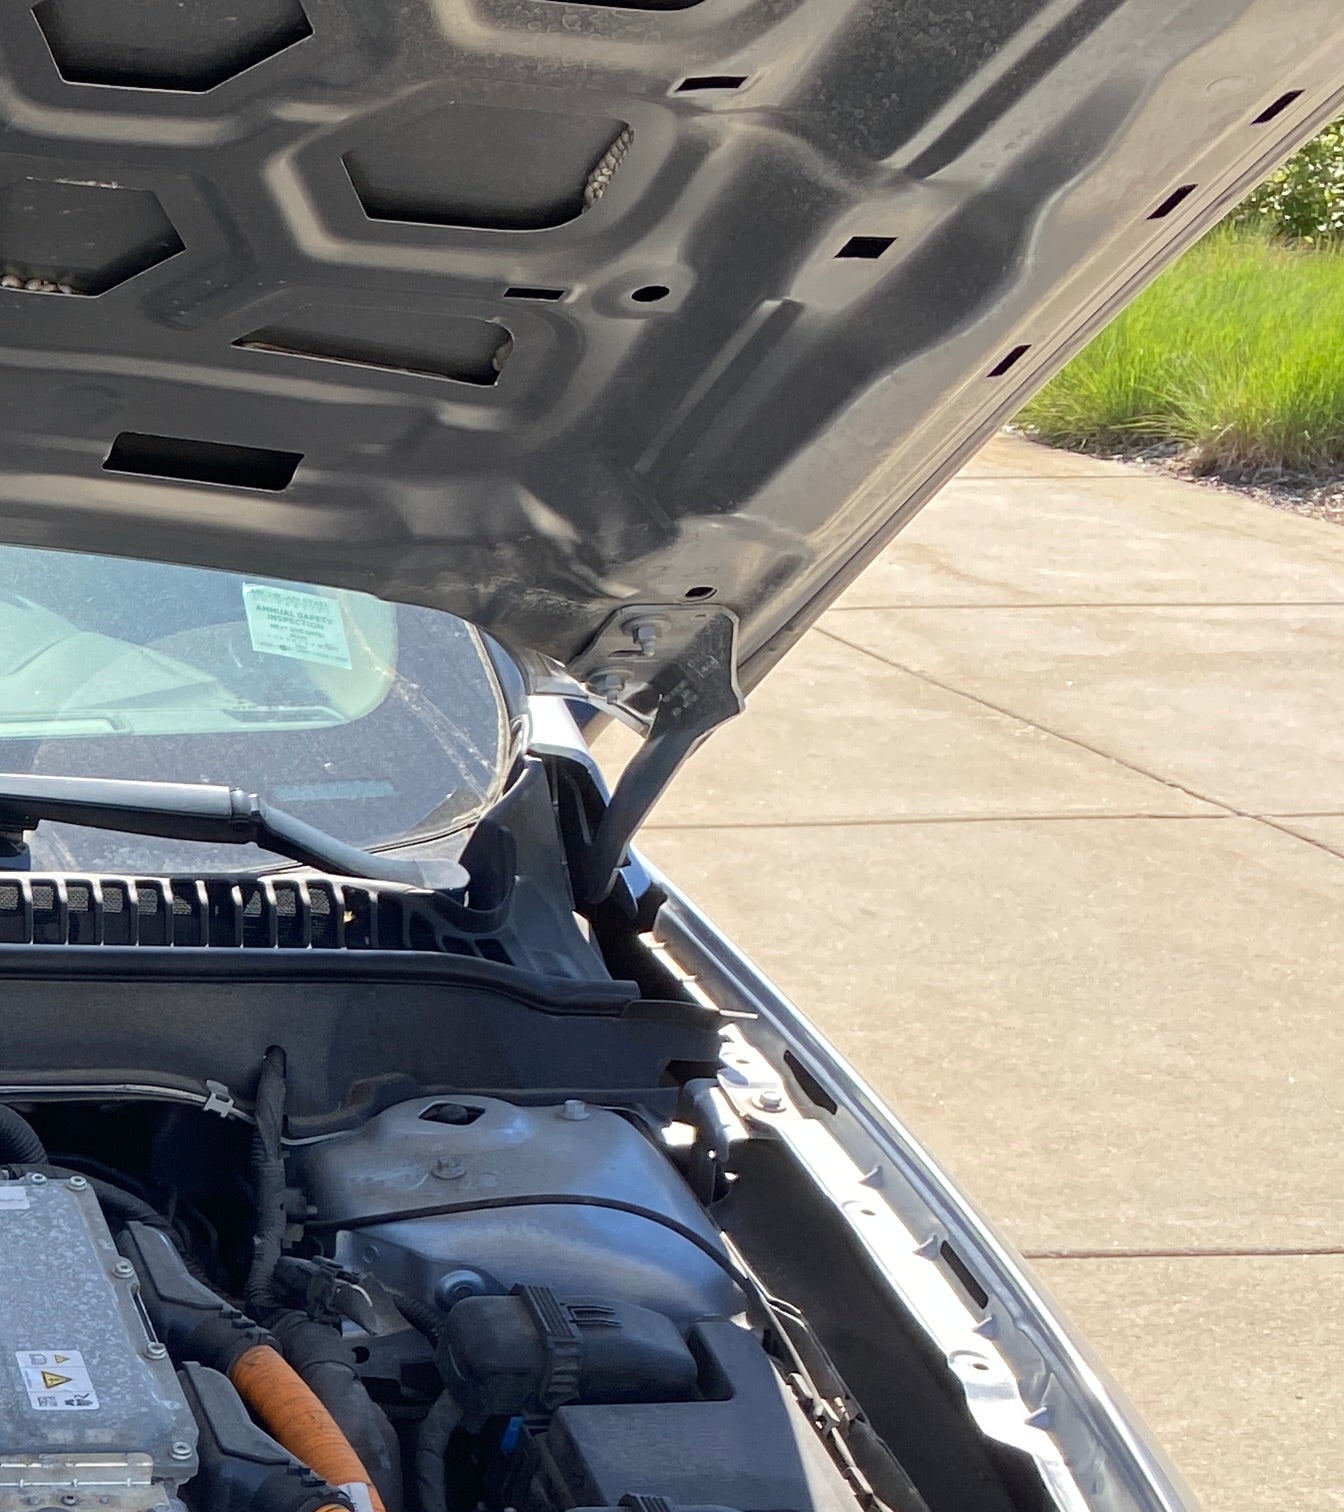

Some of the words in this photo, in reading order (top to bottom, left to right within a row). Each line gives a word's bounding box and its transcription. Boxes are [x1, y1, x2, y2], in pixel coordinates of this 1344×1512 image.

[256, 604, 294, 618] ANNUAL
[296, 612, 332, 625] SAFETY
[267, 614, 324, 630] INSPECTION
